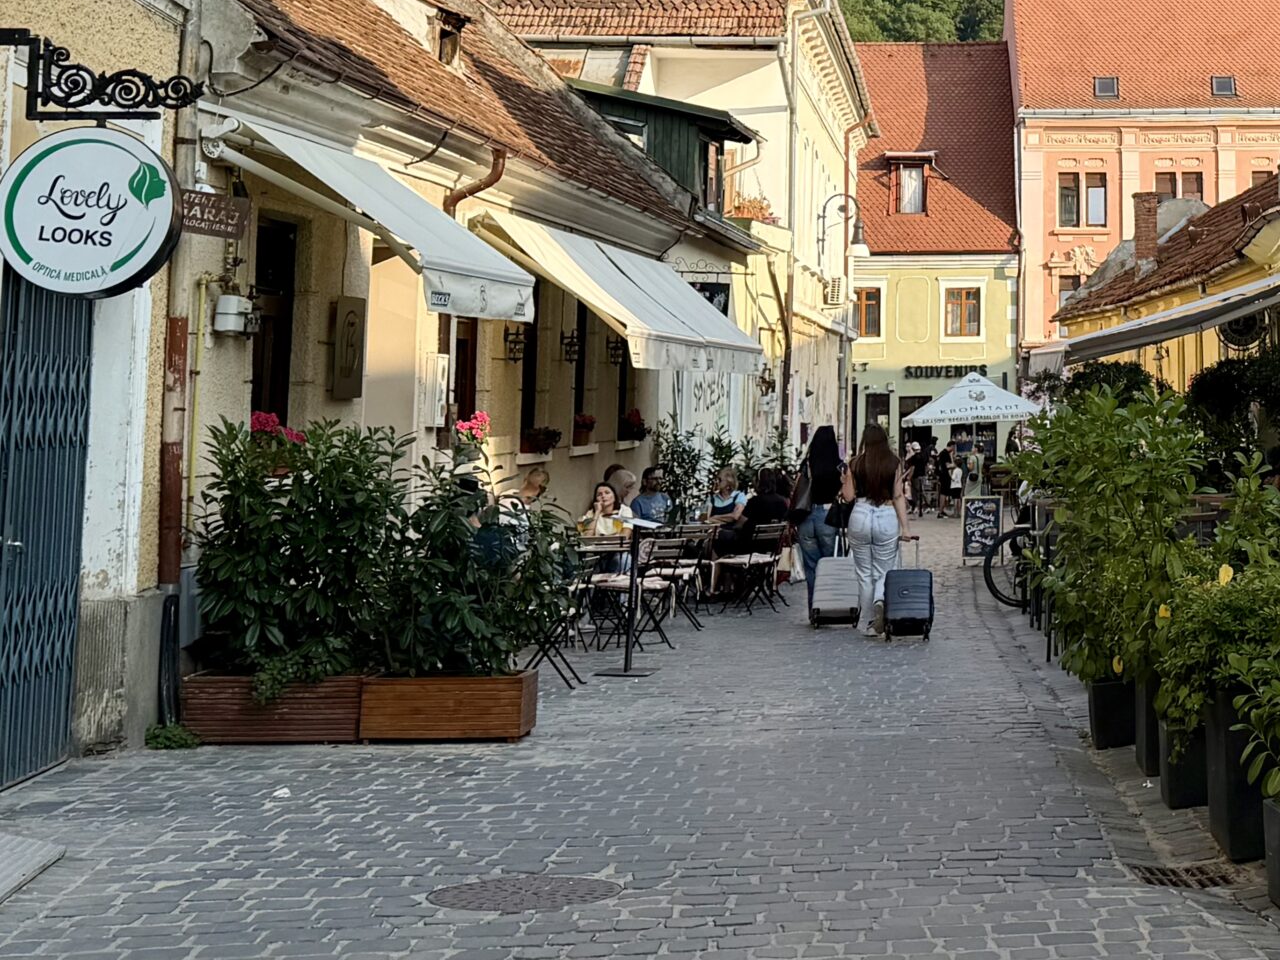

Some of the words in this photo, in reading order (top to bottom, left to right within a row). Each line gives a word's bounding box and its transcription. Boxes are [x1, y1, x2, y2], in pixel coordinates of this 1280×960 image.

[37, 174, 128, 227] Lovely
[38, 225, 113, 248] LOOKS
[904, 364, 988, 379] SOUVENIRS
[940, 404, 1020, 415] KRONSTADT
